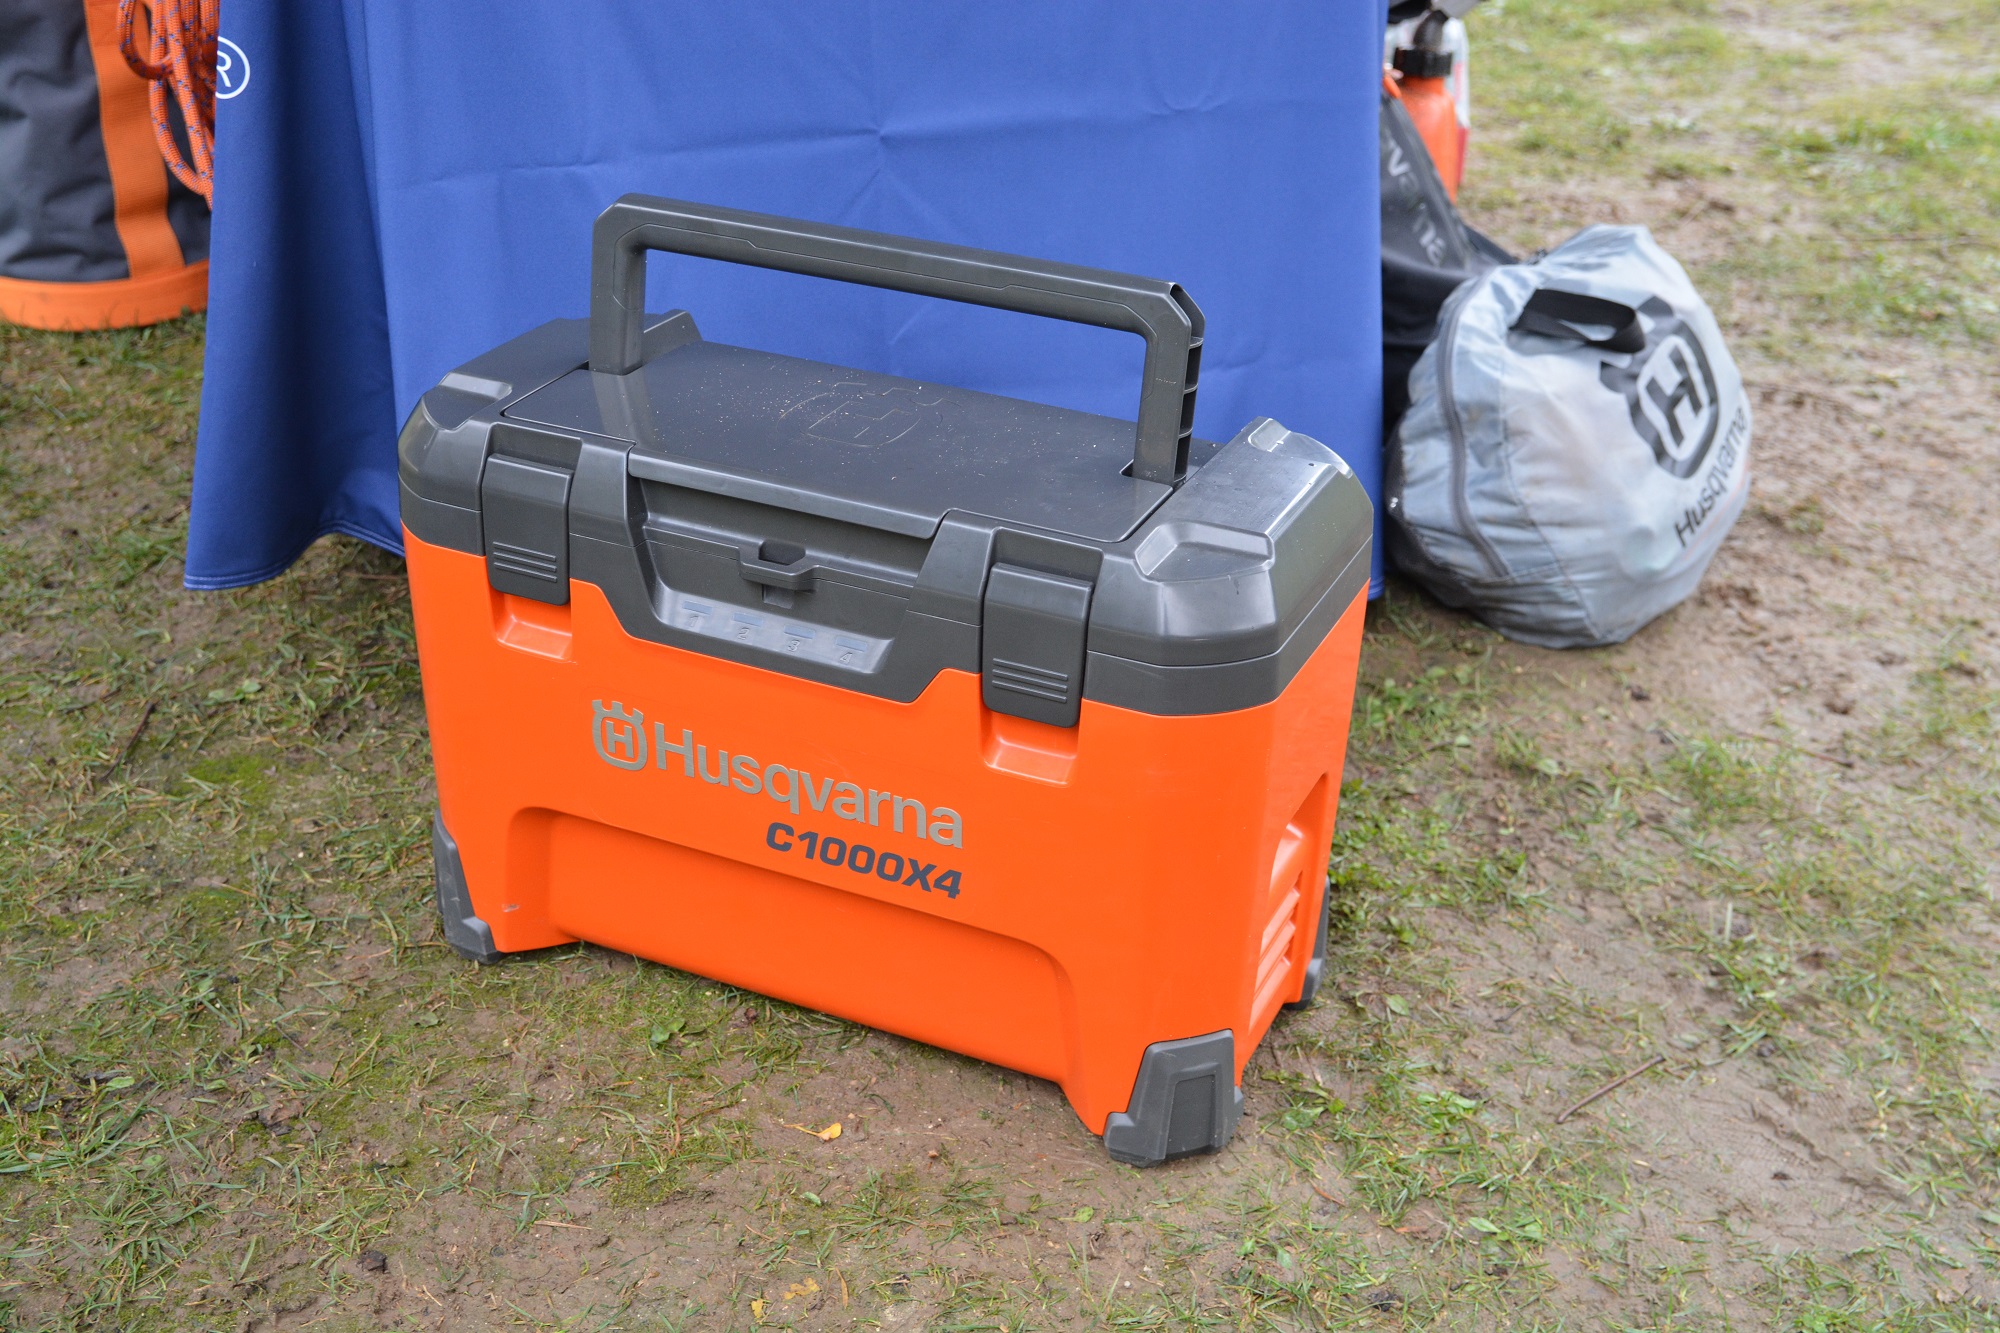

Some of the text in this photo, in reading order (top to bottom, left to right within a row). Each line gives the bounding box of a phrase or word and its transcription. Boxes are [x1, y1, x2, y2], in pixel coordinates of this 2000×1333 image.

[1674, 405, 1747, 549] Husqvarna
[689, 615, 853, 665] 1 2 3 4
[654, 721, 963, 850] Husqvarna
[765, 821, 963, 899] C1000X4
